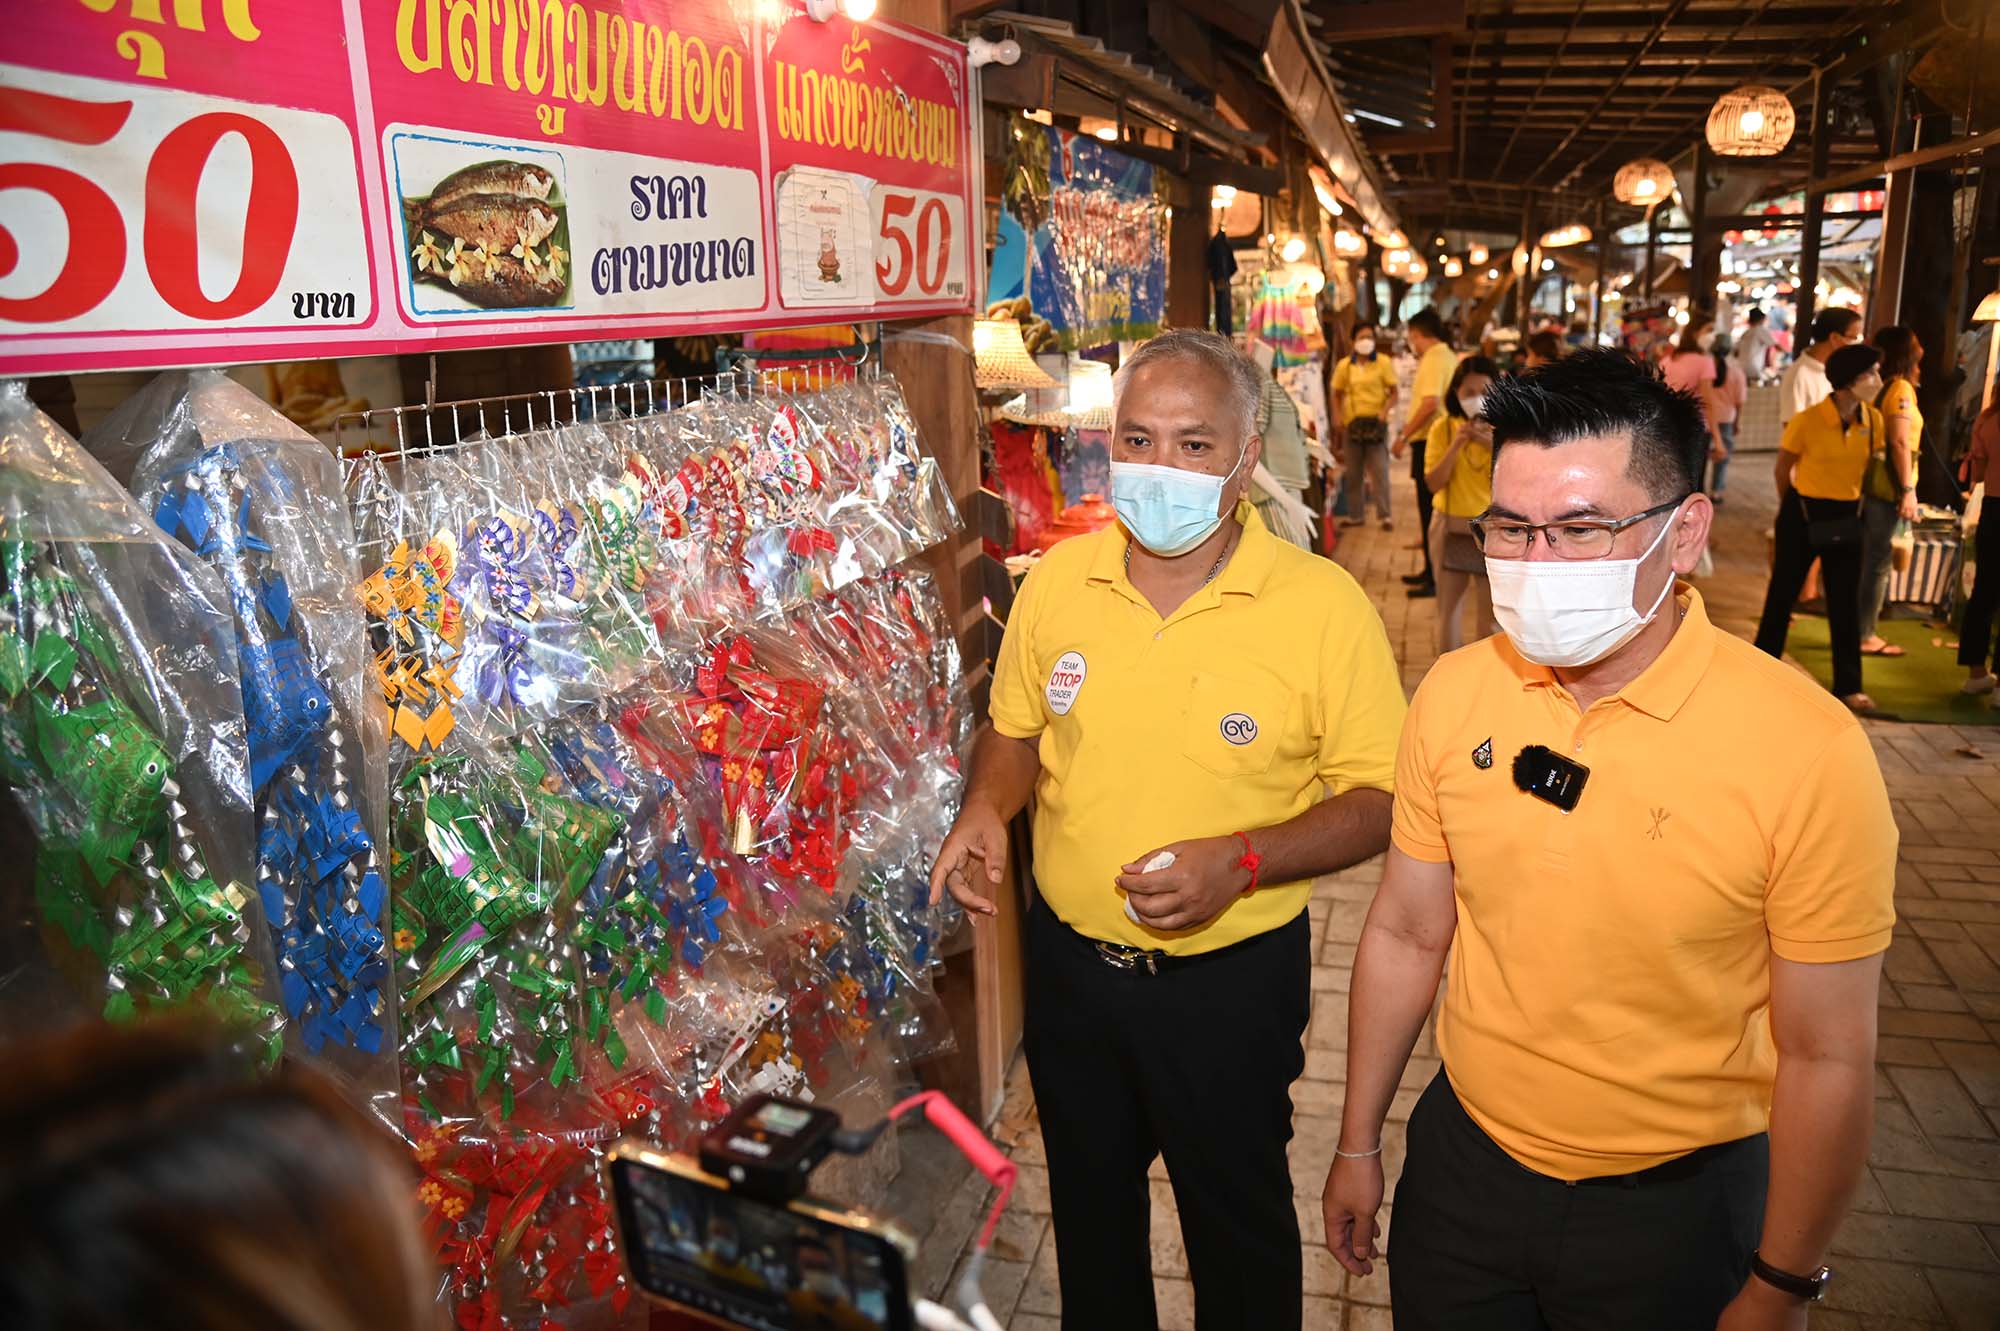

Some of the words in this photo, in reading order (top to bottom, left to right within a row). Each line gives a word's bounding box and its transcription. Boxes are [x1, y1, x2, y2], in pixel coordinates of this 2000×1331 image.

[396, 0, 744, 136] ปลาทูมนทอด
[630, 175, 708, 221] ราคา
[875, 194, 952, 296] 50
[591, 237, 755, 296] ตามขนาด
[291, 291, 355, 318] บาท
[1050, 671, 1082, 687] OTOP
[1061, 661, 1079, 670] TEAM
[1049, 689, 1072, 699] TRADER
